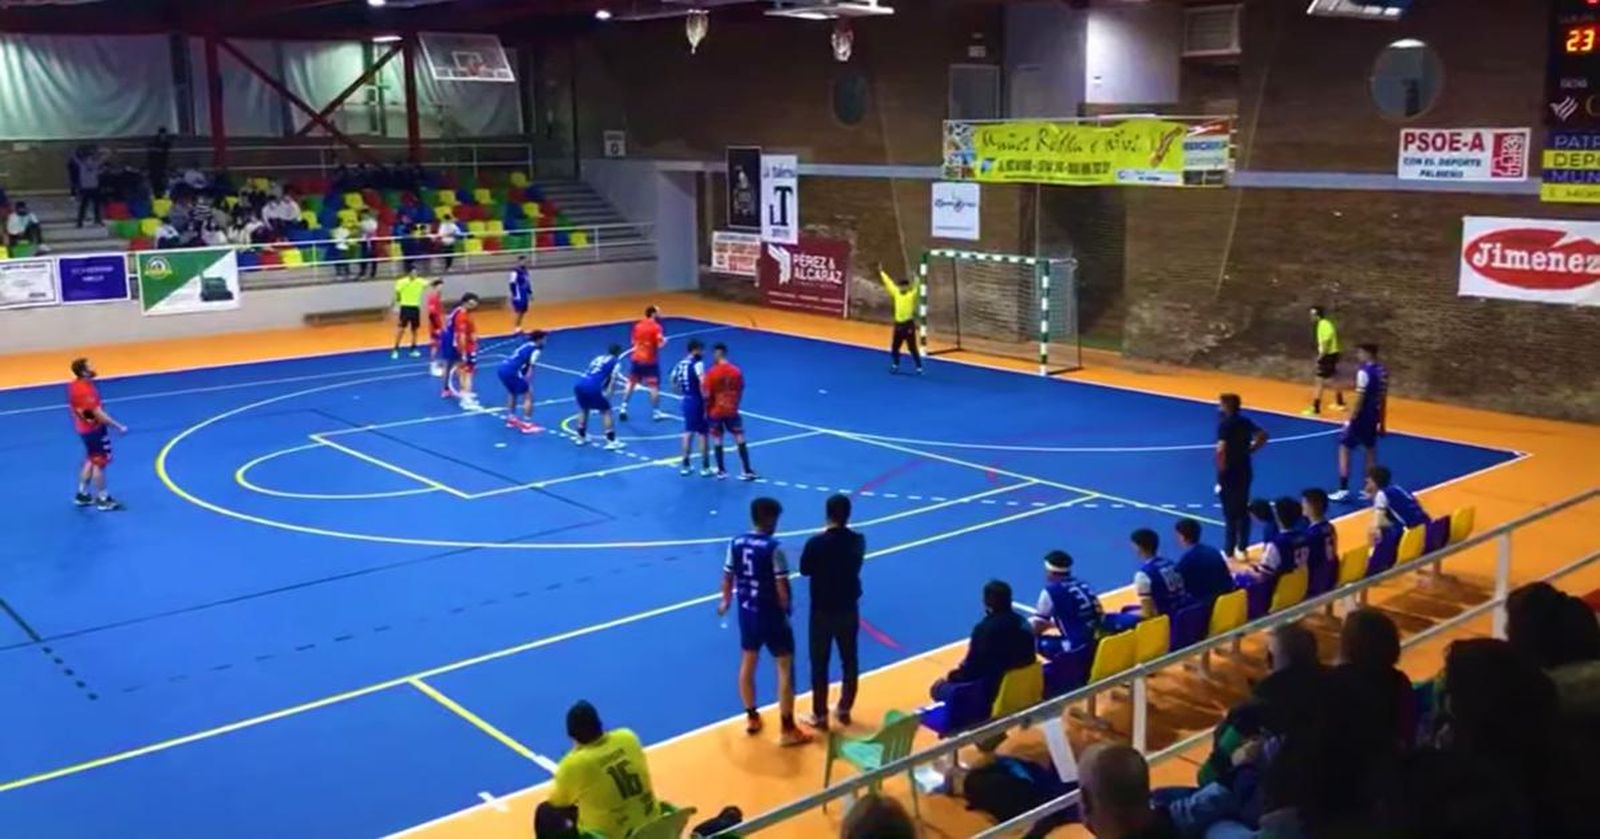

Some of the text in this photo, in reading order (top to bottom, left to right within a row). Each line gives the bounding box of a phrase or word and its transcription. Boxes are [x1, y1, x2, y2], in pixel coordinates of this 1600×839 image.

[1566, 29, 1595, 51] 23
[1404, 132, 1485, 152] PSOE-A
[1403, 157, 1422, 166] CON
[1439, 157, 1481, 167] DEPORTE
[793, 252, 836, 270] PÉREZ &
[793, 268, 843, 284] ALCARAZ
[743, 548, 754, 576] 5
[607, 760, 643, 800] 16
